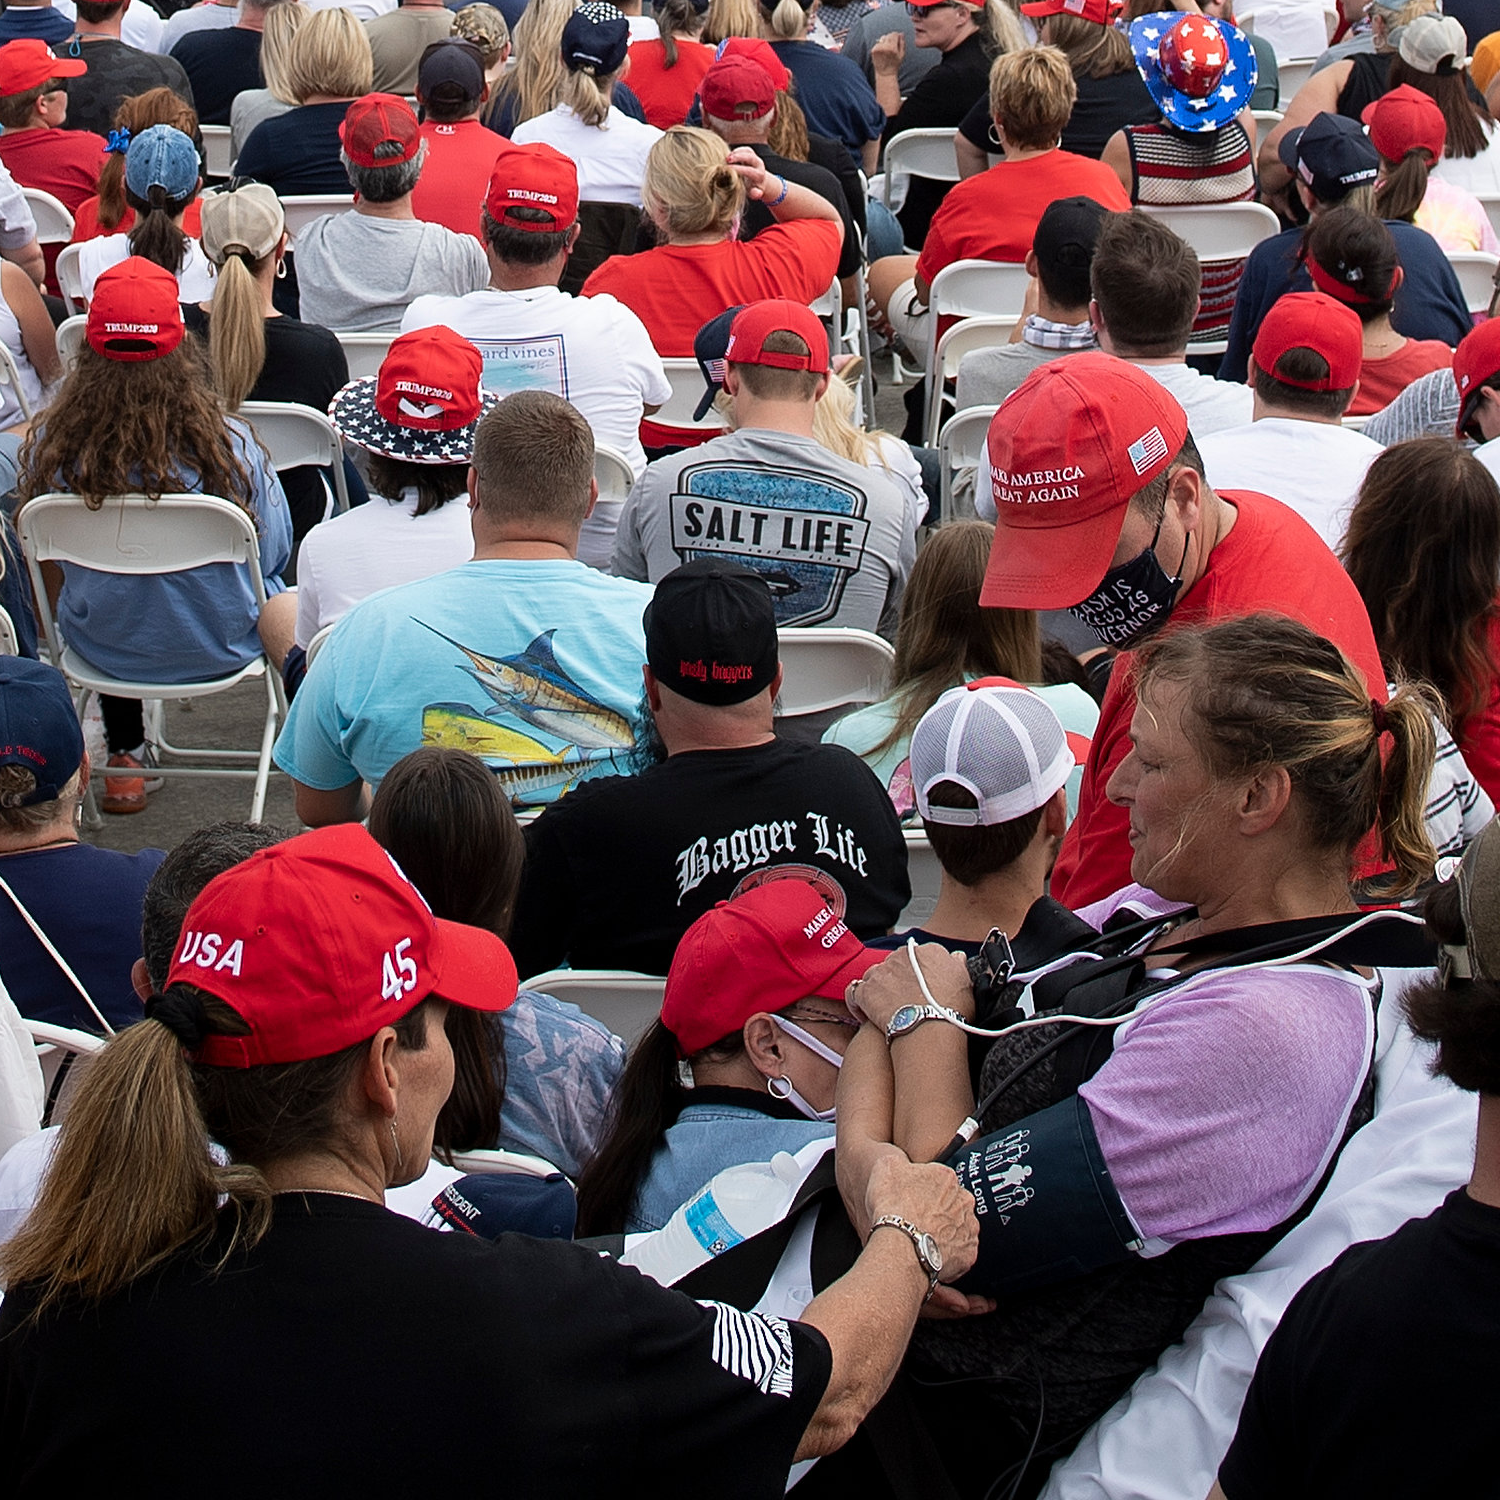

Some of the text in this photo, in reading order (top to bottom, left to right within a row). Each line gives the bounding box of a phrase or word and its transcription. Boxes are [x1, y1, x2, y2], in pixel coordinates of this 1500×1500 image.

[507, 189, 558, 204] TRUMP2020
[104, 322, 158, 334] TRUMP2020
[482, 344, 556, 361] ard vines
[395, 380, 453, 401] TRUMP2020
[1011, 465, 1086, 487] AMERICA
[1027, 485, 1080, 504] AGAIN
[684, 502, 854, 557] SALT LIFE
[1111, 579, 1132, 599] IS
[1128, 590, 1150, 613] AS
[675, 812, 868, 907] Bagger Life
[803, 908, 832, 940] MAKE
[822, 920, 849, 949] GREA
[179, 931, 245, 977] USA
[381, 937, 417, 1001] 45
[968, 1151, 988, 1215] Adult Long
